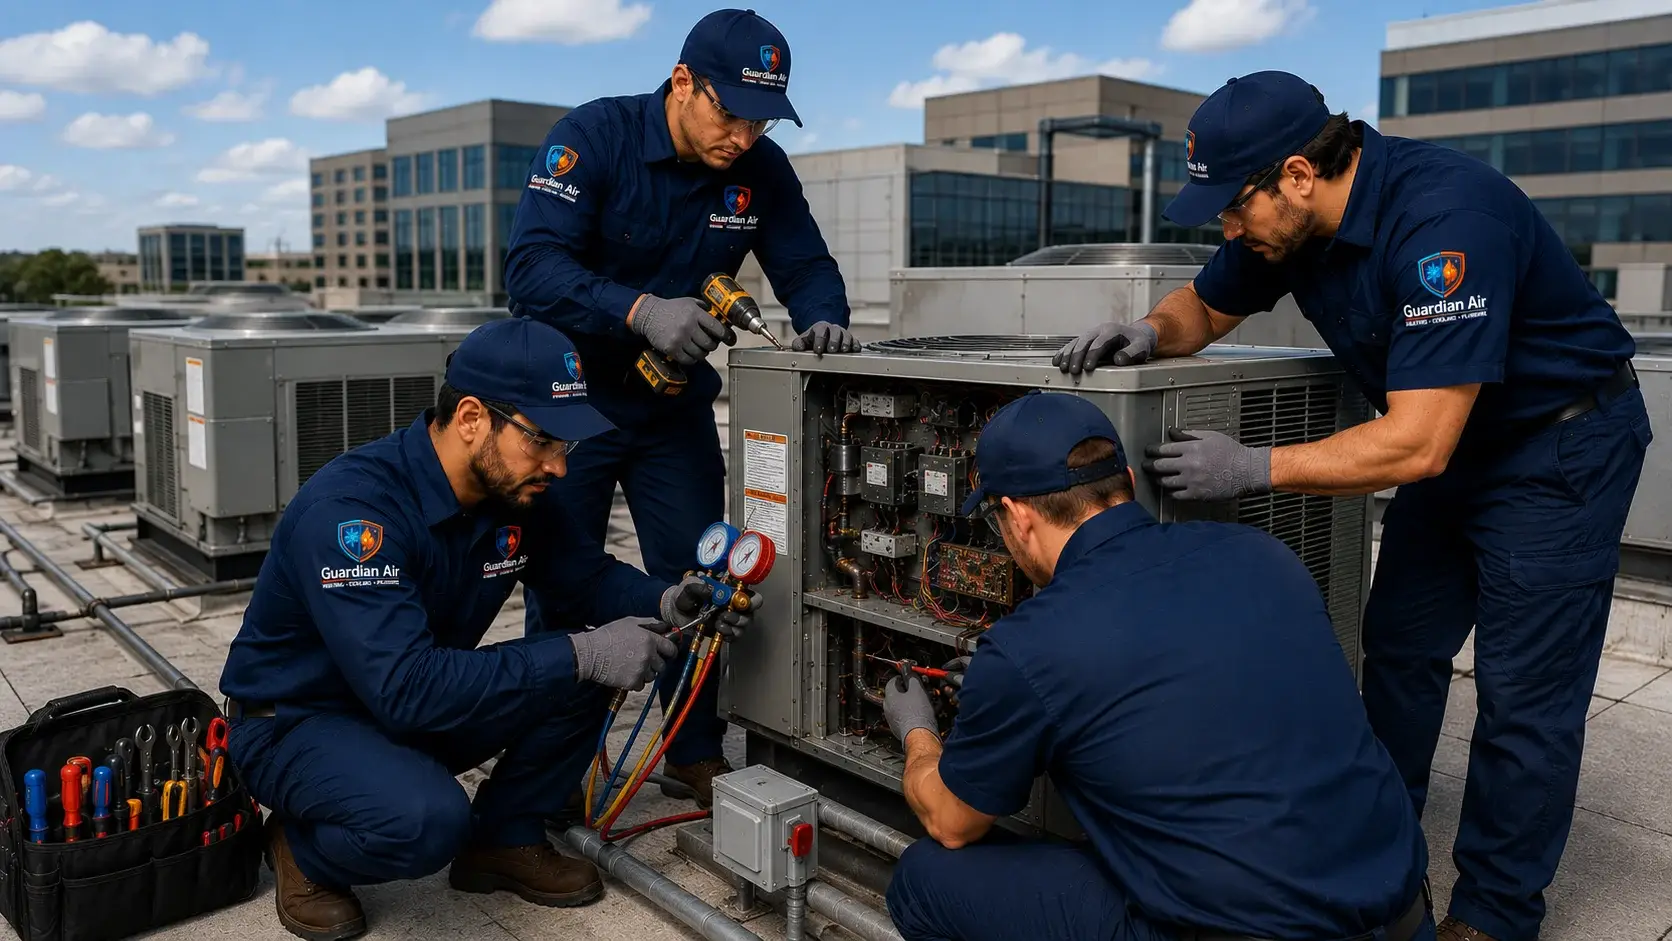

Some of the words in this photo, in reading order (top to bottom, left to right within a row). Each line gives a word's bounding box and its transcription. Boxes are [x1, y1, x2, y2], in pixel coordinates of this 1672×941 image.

[565, 184, 580, 196] Air
[1403, 300, 1464, 318] Guardian
[1467, 295, 1487, 309] Air
[321, 564, 379, 580] Guardian
[382, 564, 400, 577] Air
